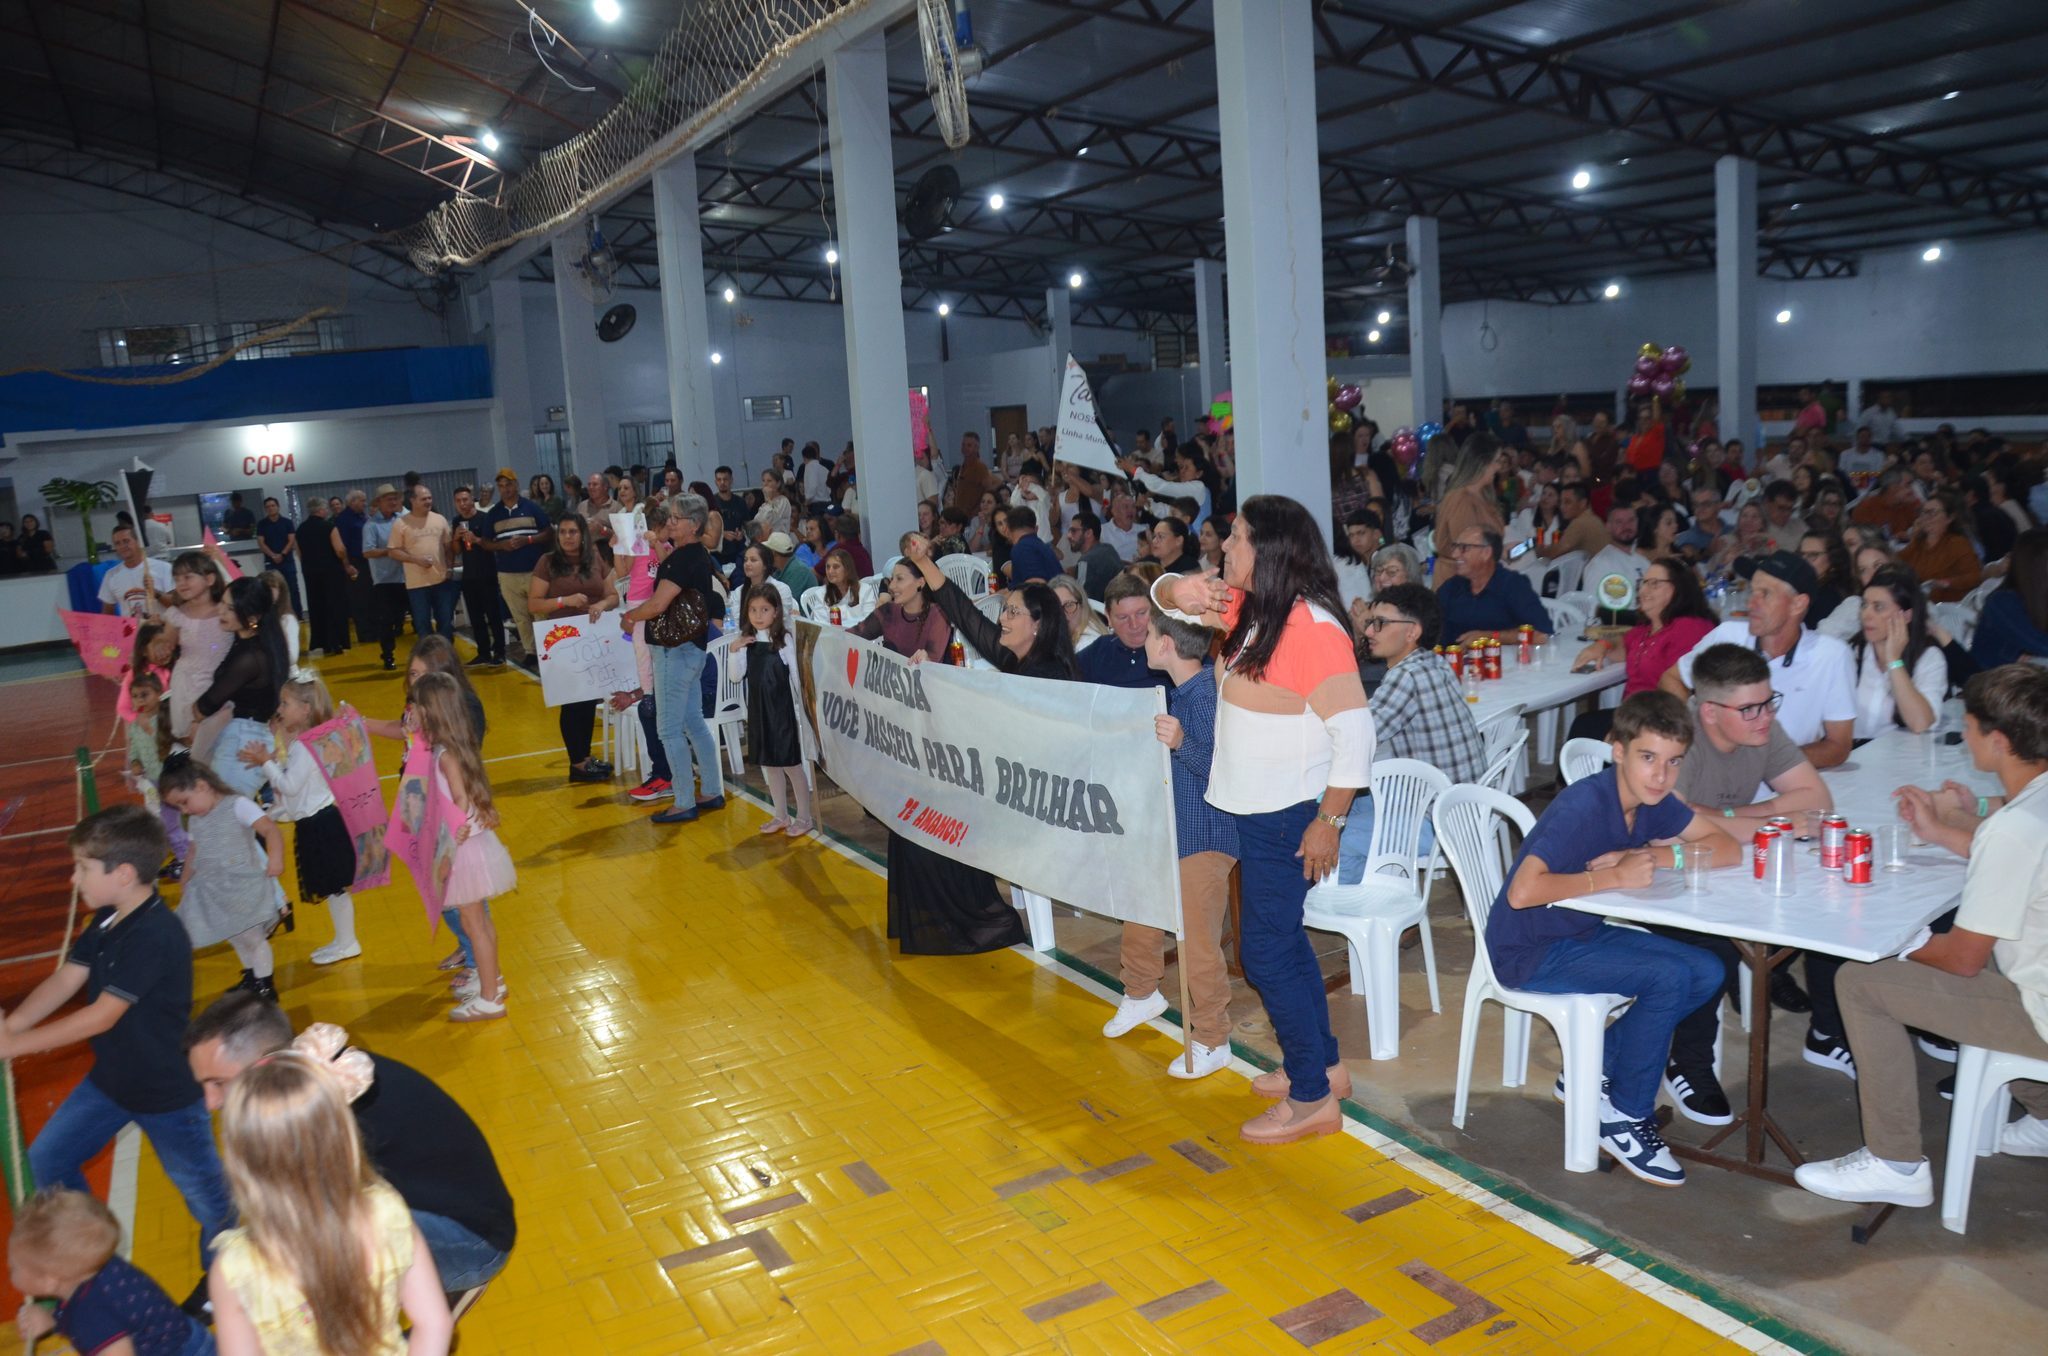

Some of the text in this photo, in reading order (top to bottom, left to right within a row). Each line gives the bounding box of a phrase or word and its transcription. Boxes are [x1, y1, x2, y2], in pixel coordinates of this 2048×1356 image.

[1061, 428, 1083, 439] Linha
[243, 453, 295, 476] COPA
[823, 690, 1125, 835] VOCÊ NASCEU PARA BRILHAR
[897, 797, 969, 848] TE AMAMOS!
